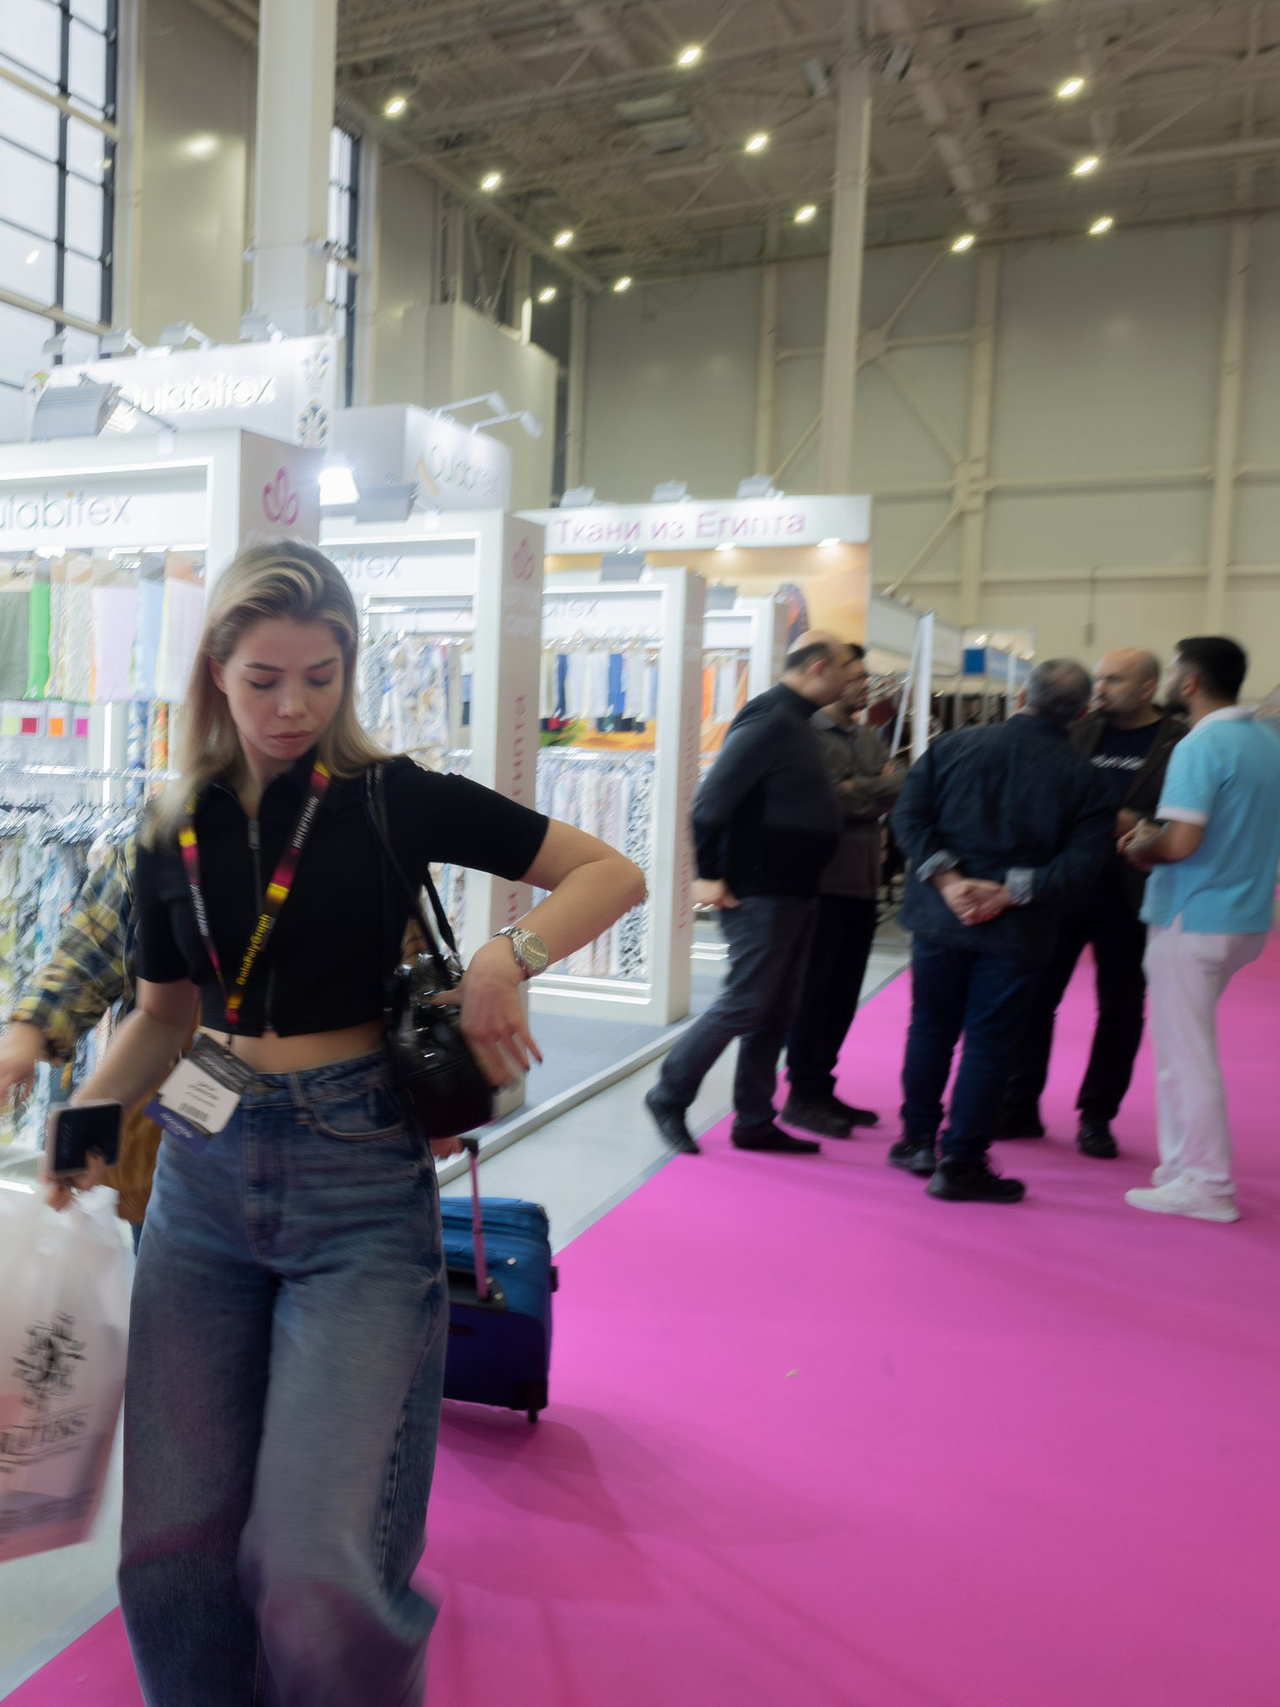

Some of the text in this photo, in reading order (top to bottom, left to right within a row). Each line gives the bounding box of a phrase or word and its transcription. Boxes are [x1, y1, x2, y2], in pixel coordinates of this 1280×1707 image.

[554, 510, 806, 545] Ткани из Египта
